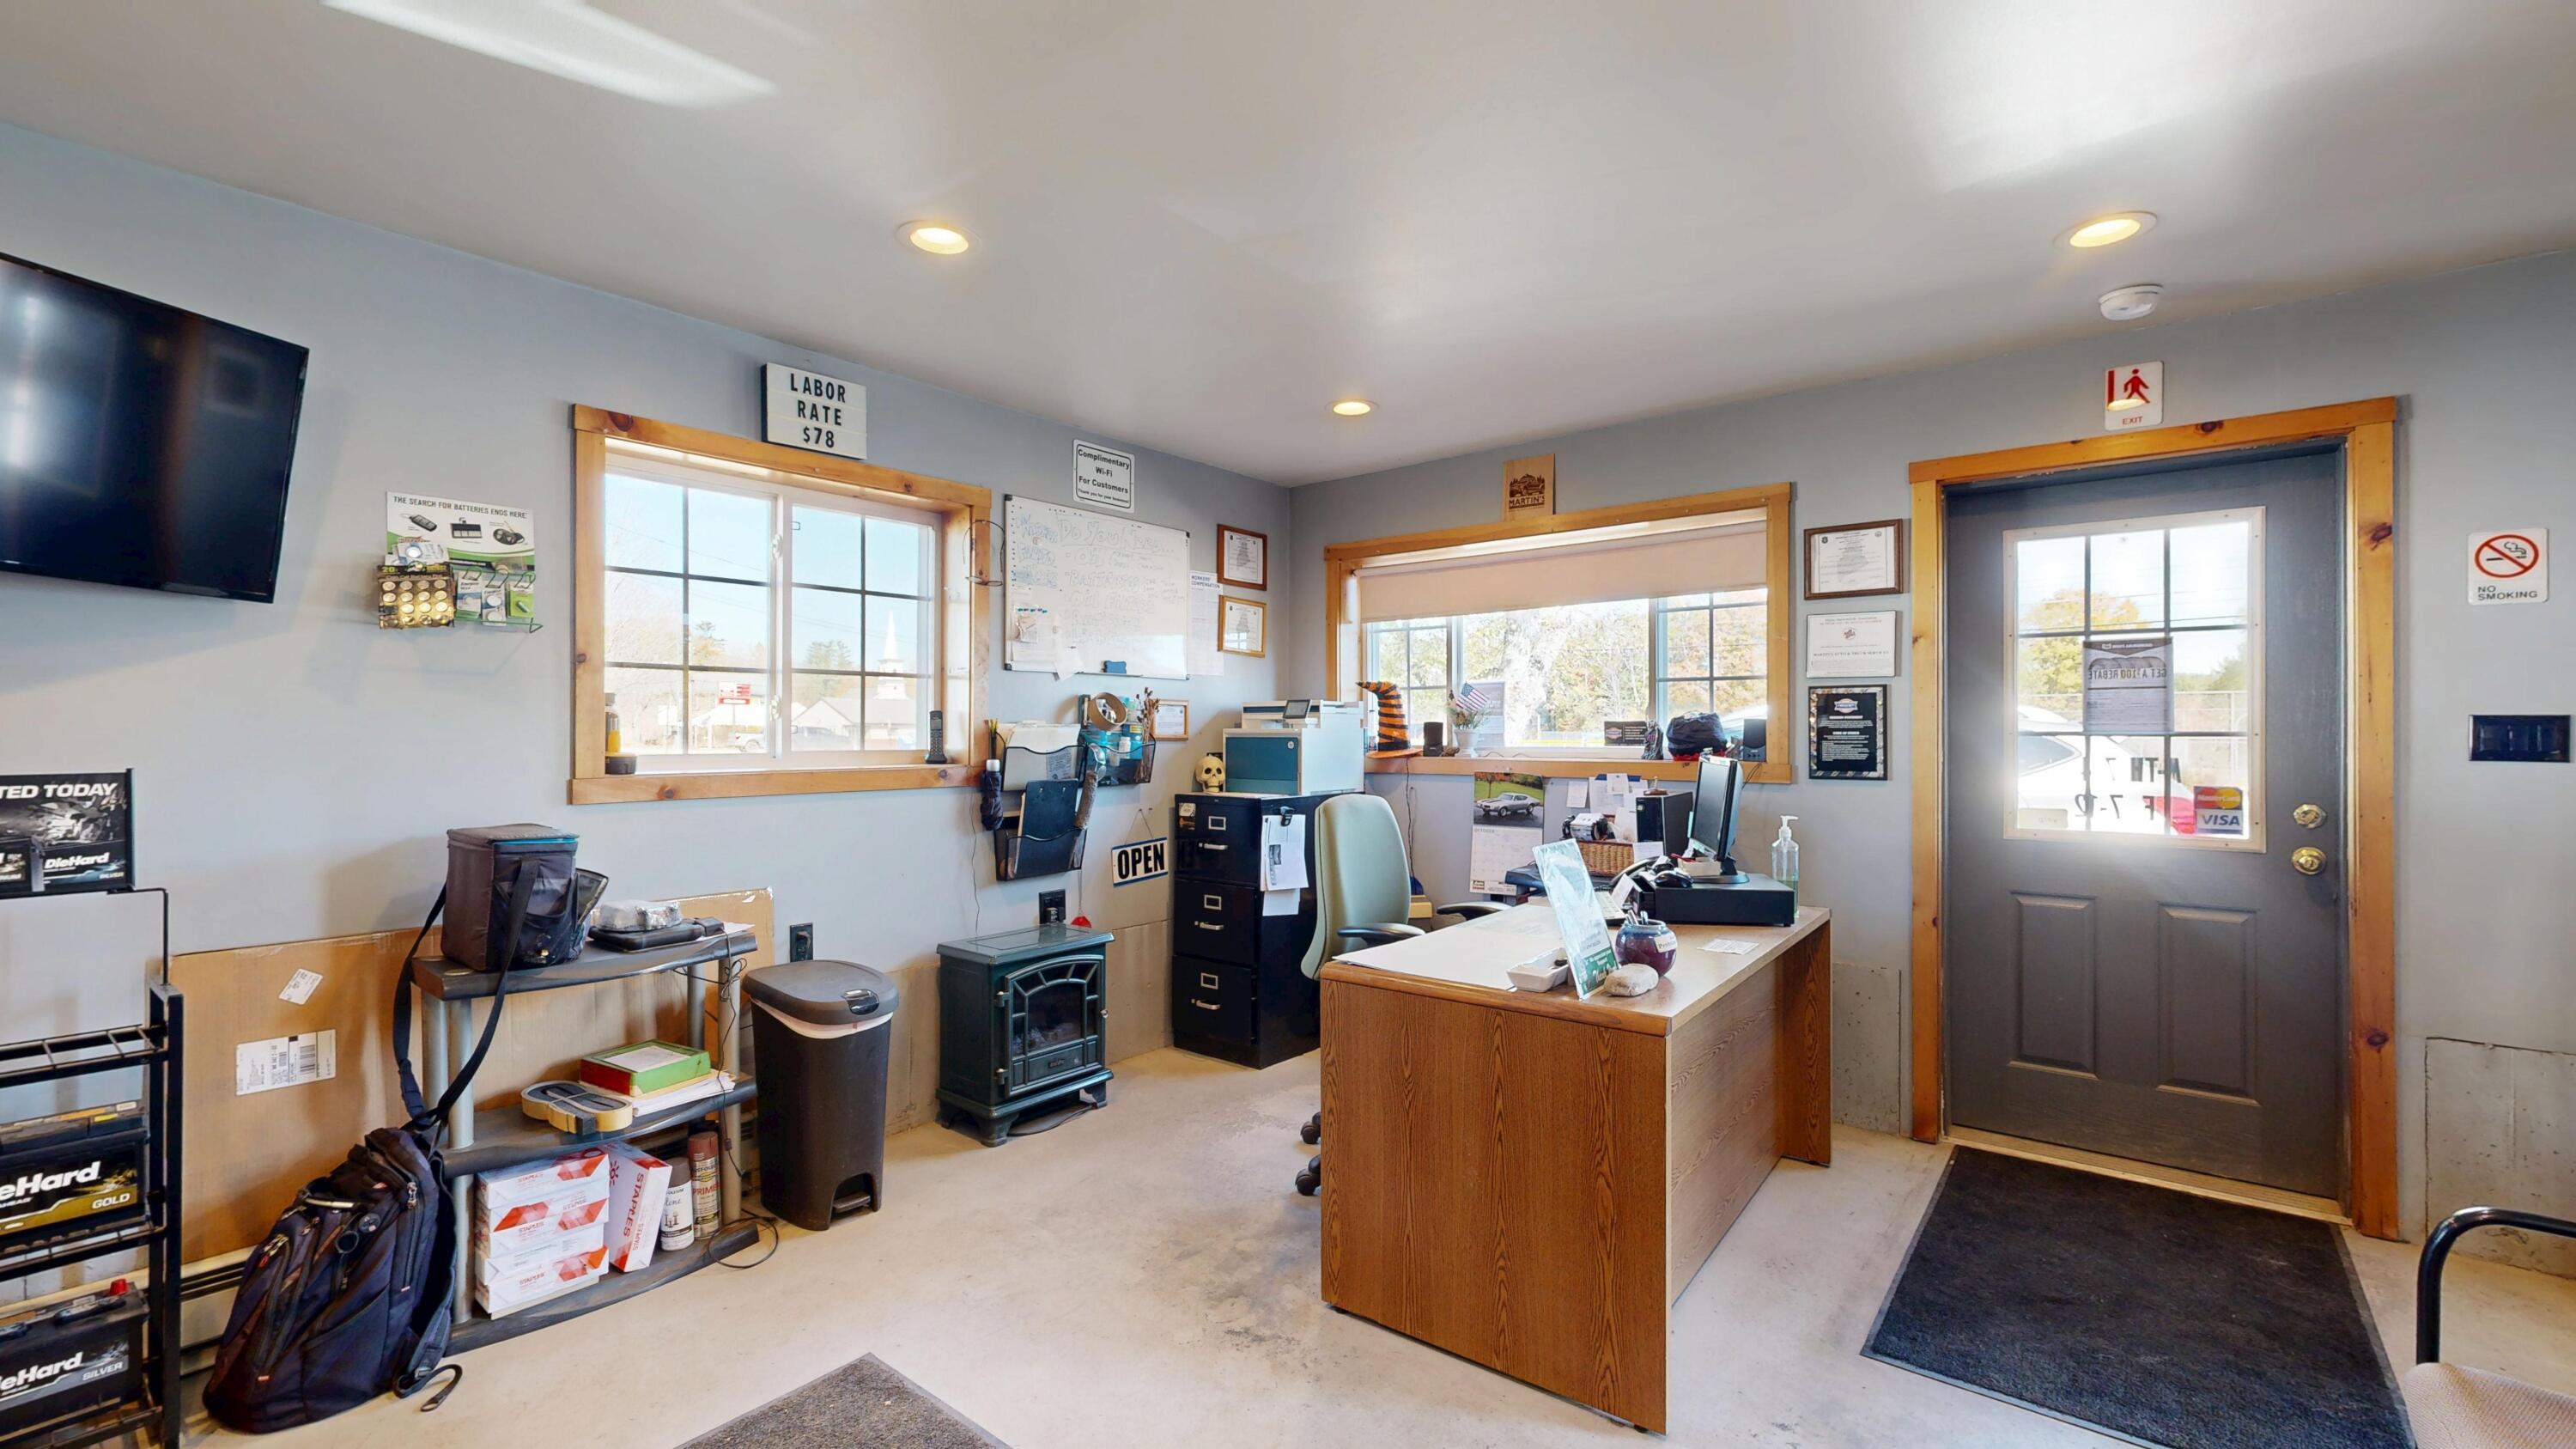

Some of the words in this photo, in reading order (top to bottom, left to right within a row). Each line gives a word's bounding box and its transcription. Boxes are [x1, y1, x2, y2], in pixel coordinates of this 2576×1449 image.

[790, 373, 846, 403] LABOR
[797, 399, 841, 426] RATE
[2122, 416, 2143, 425] EXIT
[803, 426, 835, 448] $78
[1078, 448, 1130, 470] Complimentary
[1095, 466, 1113, 477] Wi-Fi
[1078, 475, 1091, 484] For
[1091, 479, 1128, 494] Customers
[393, 496, 407, 504] THE
[409, 498, 436, 508] SEARCH
[453, 504, 489, 514] BATTERIES
[490, 508, 508, 517] ENDS
[1509, 495, 1546, 505] MARTIN'S
[2477, 590, 2538, 601] SMOKING
[43, 782, 118, 798] TODAY
[2202, 815, 2240, 826] VISA
[44, 852, 110, 869] DieHard
[1117, 843, 1164, 880] OPEN
[91, 1193, 131, 1209] GOLD
[623, 1172, 644, 1237] STAPLES
[518, 1222, 545, 1233] STAPLES
[519, 1272, 545, 1285] STAPLES
[82, 1361, 123, 1381] SILVER
